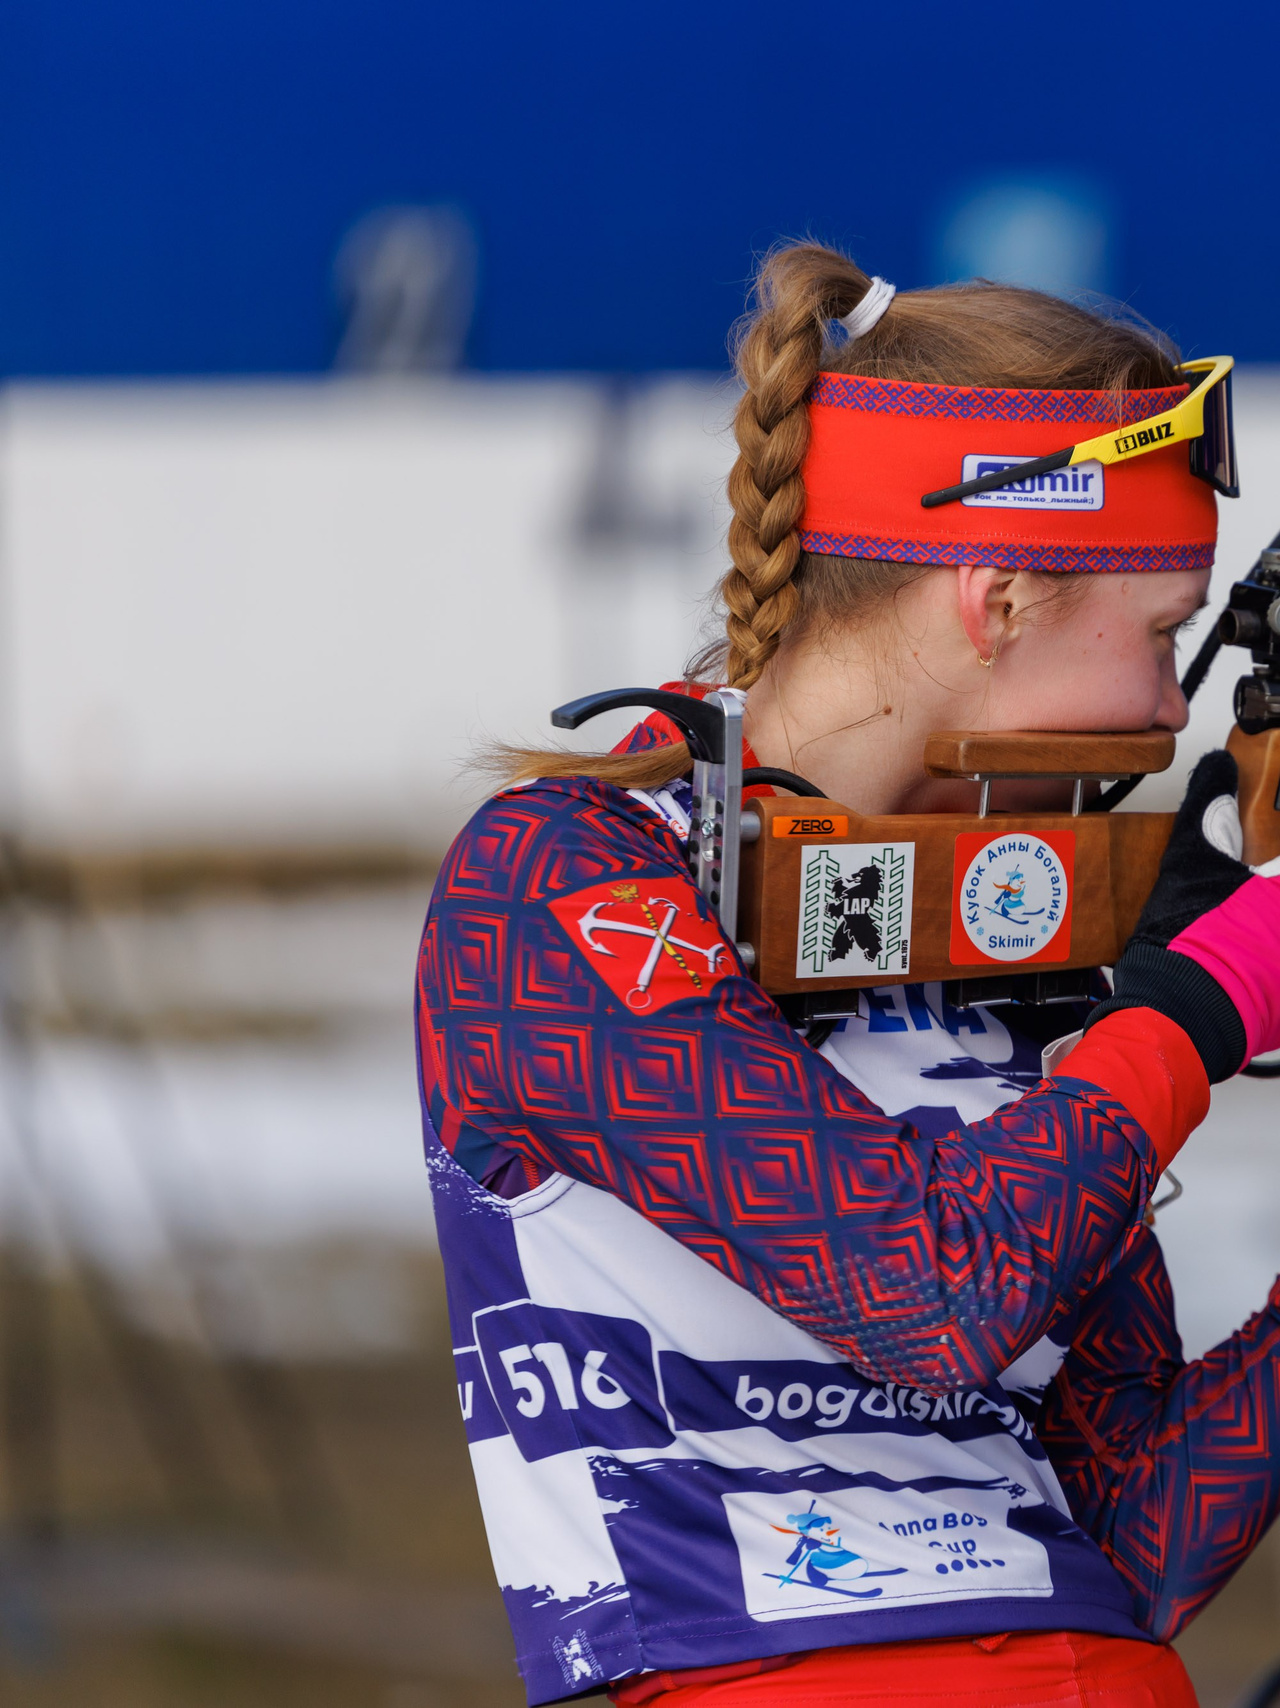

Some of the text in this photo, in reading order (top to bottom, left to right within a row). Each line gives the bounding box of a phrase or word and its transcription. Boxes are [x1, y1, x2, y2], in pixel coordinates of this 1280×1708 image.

[1136, 421, 1175, 447] BLIZ
[788, 819, 835, 835] ZERO
[966, 841, 1061, 924] Кубок Анны Богалий
[843, 897, 871, 915] LAP
[988, 934, 1036, 949] Skimir
[498, 1341, 632, 1418] 516
[878, 1516, 938, 1537] nna
